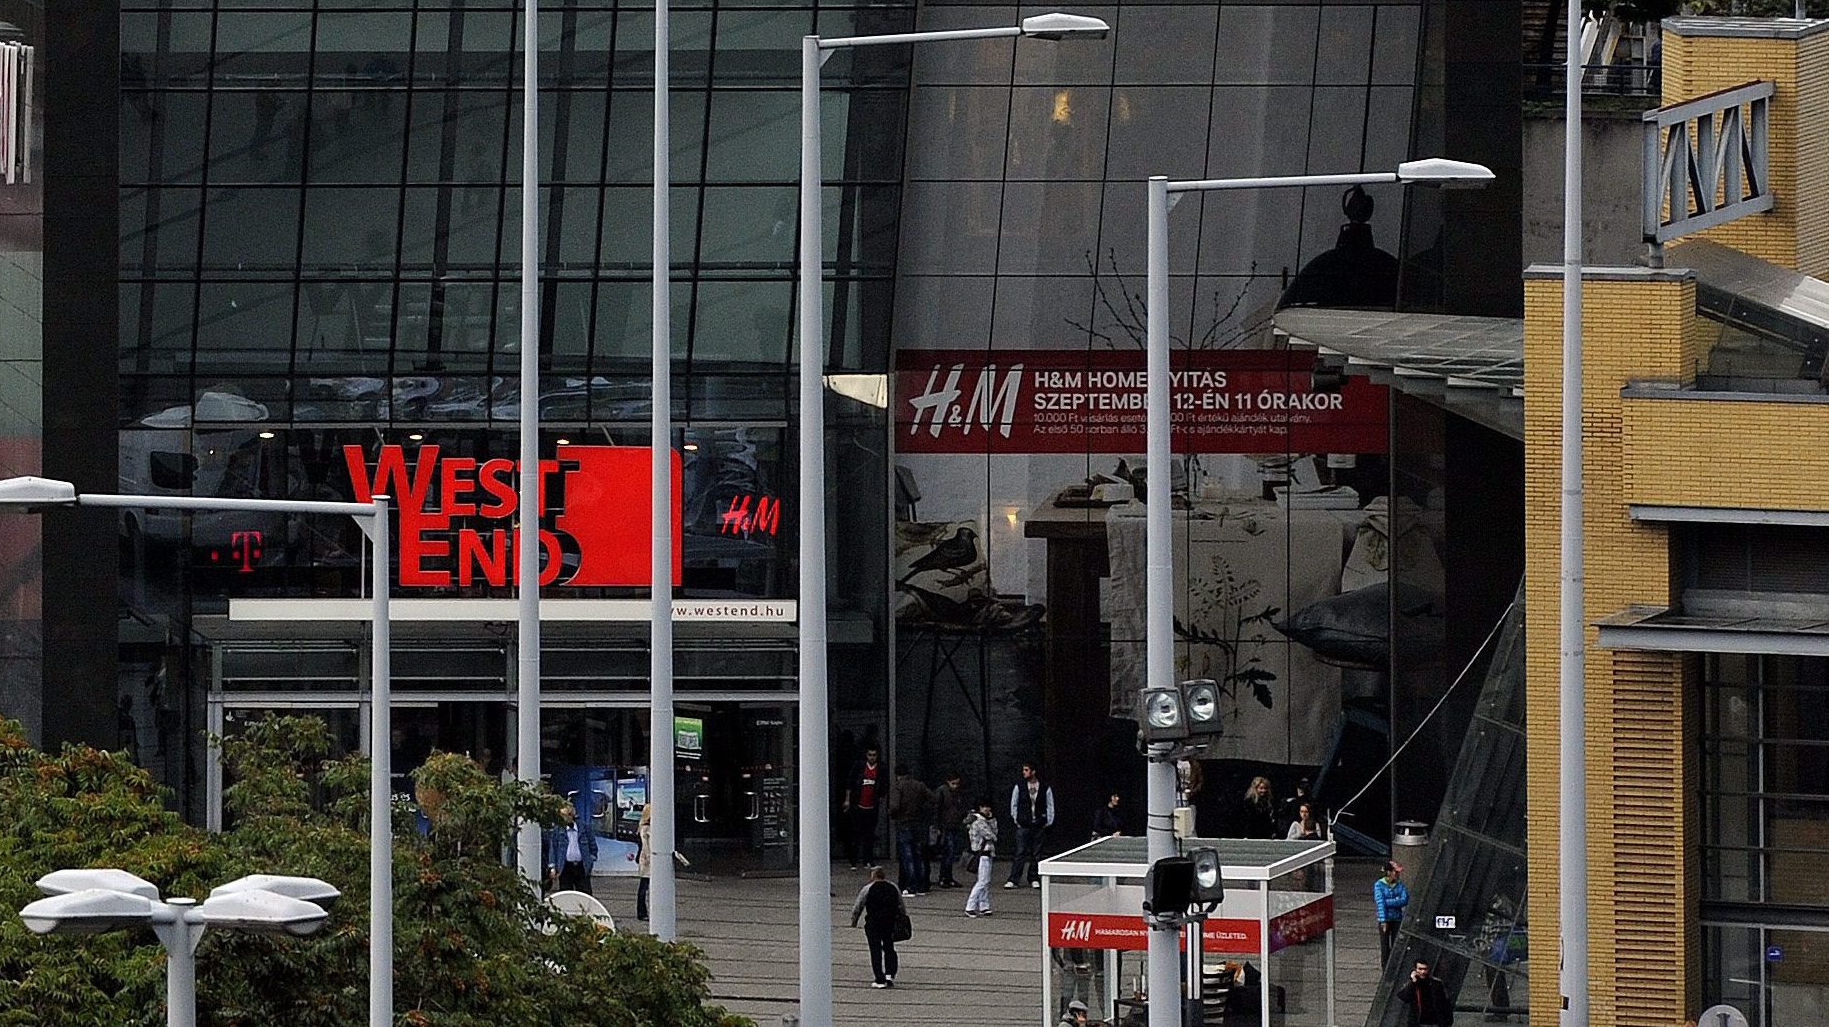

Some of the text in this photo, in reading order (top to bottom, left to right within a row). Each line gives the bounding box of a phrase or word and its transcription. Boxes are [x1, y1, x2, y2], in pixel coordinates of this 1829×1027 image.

[1034, 367, 1227, 388] H&M HOME YITÁS
[908, 363, 1025, 439] H&M
[1173, 389, 1230, 410] 12-ÉN
[1235, 393, 1252, 409] 11
[1257, 389, 1343, 410] ÓRAKOR
[343, 444, 559, 519] WEST
[721, 494, 782, 536] H&M
[399, 512, 563, 587] END
[1061, 919, 1093, 942] H&M
